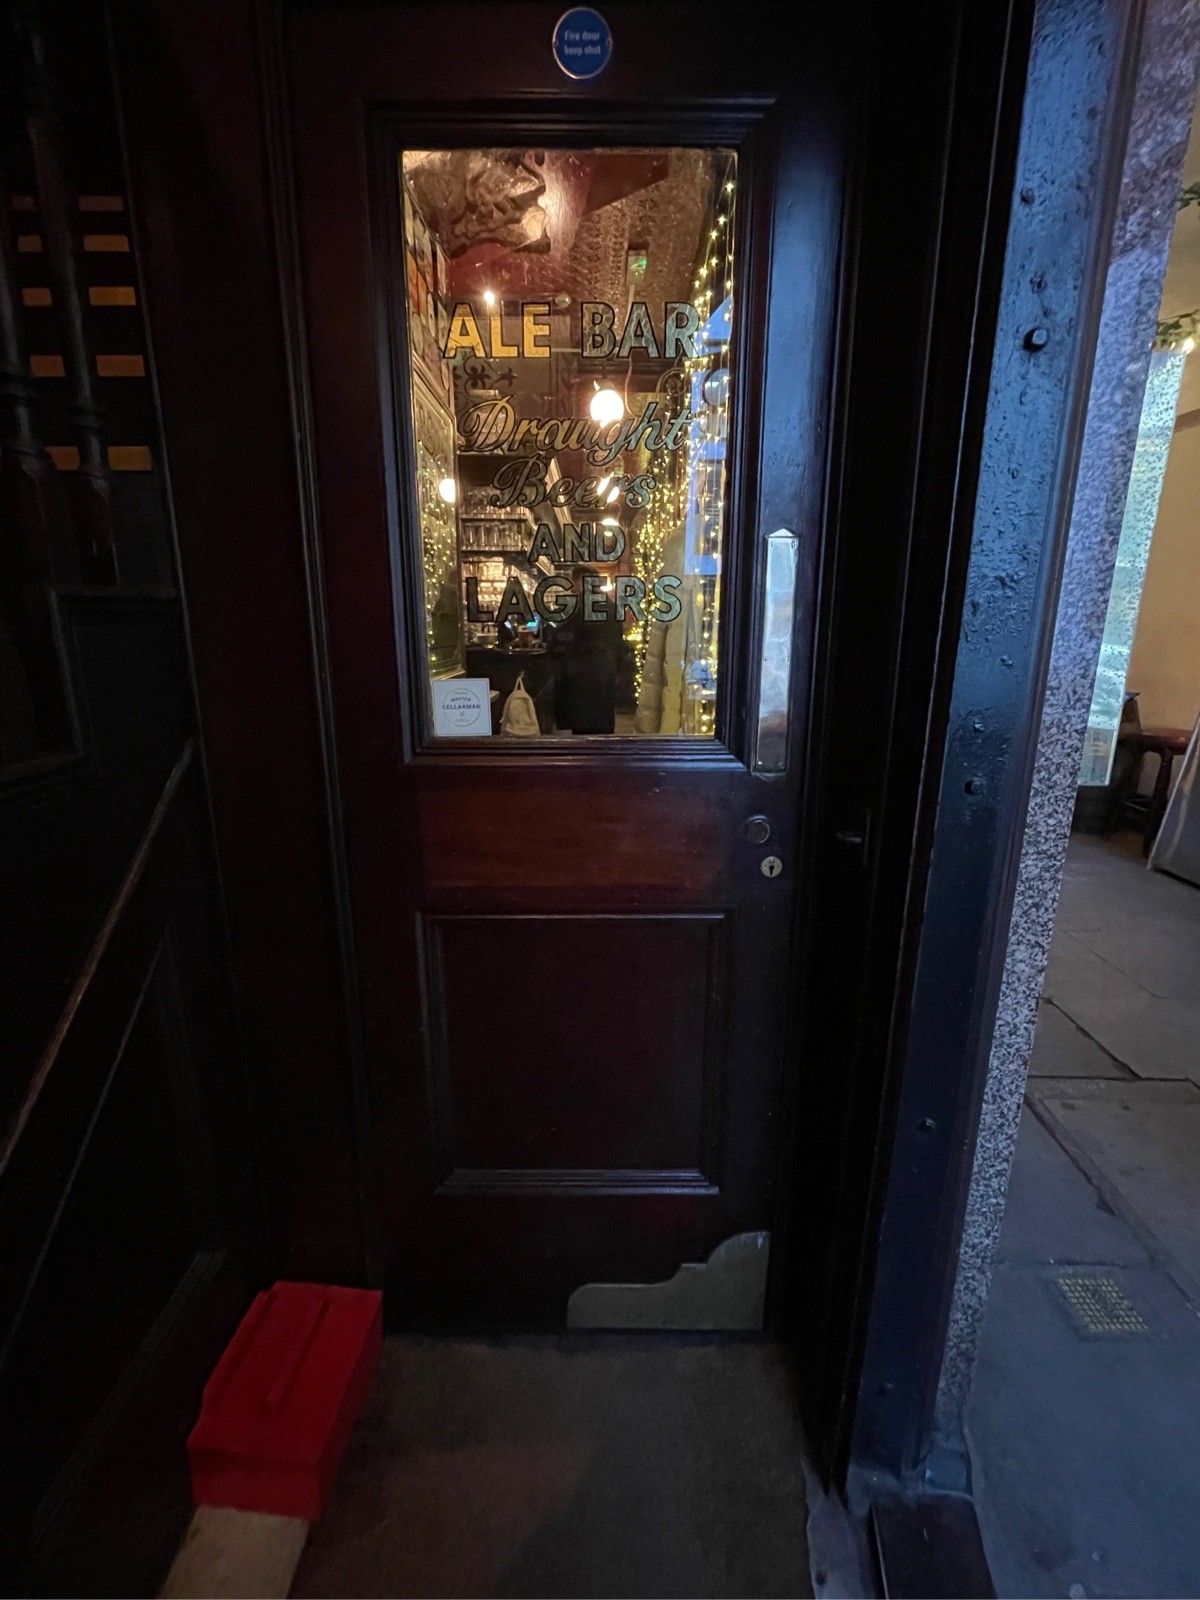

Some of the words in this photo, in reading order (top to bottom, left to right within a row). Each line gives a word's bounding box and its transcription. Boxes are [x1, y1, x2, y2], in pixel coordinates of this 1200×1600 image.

[564, 30, 580, 41] Fire
[582, 30, 600, 41] door
[564, 45, 583, 56] keep
[584, 45, 601, 55] shut
[443, 302, 552, 359] ALE
[581, 302, 703, 359] BAR
[458, 394, 695, 467] Draught
[490, 453, 657, 509] Beers
[528, 523, 626, 563] AND
[465, 574, 683, 623] LAGERS
